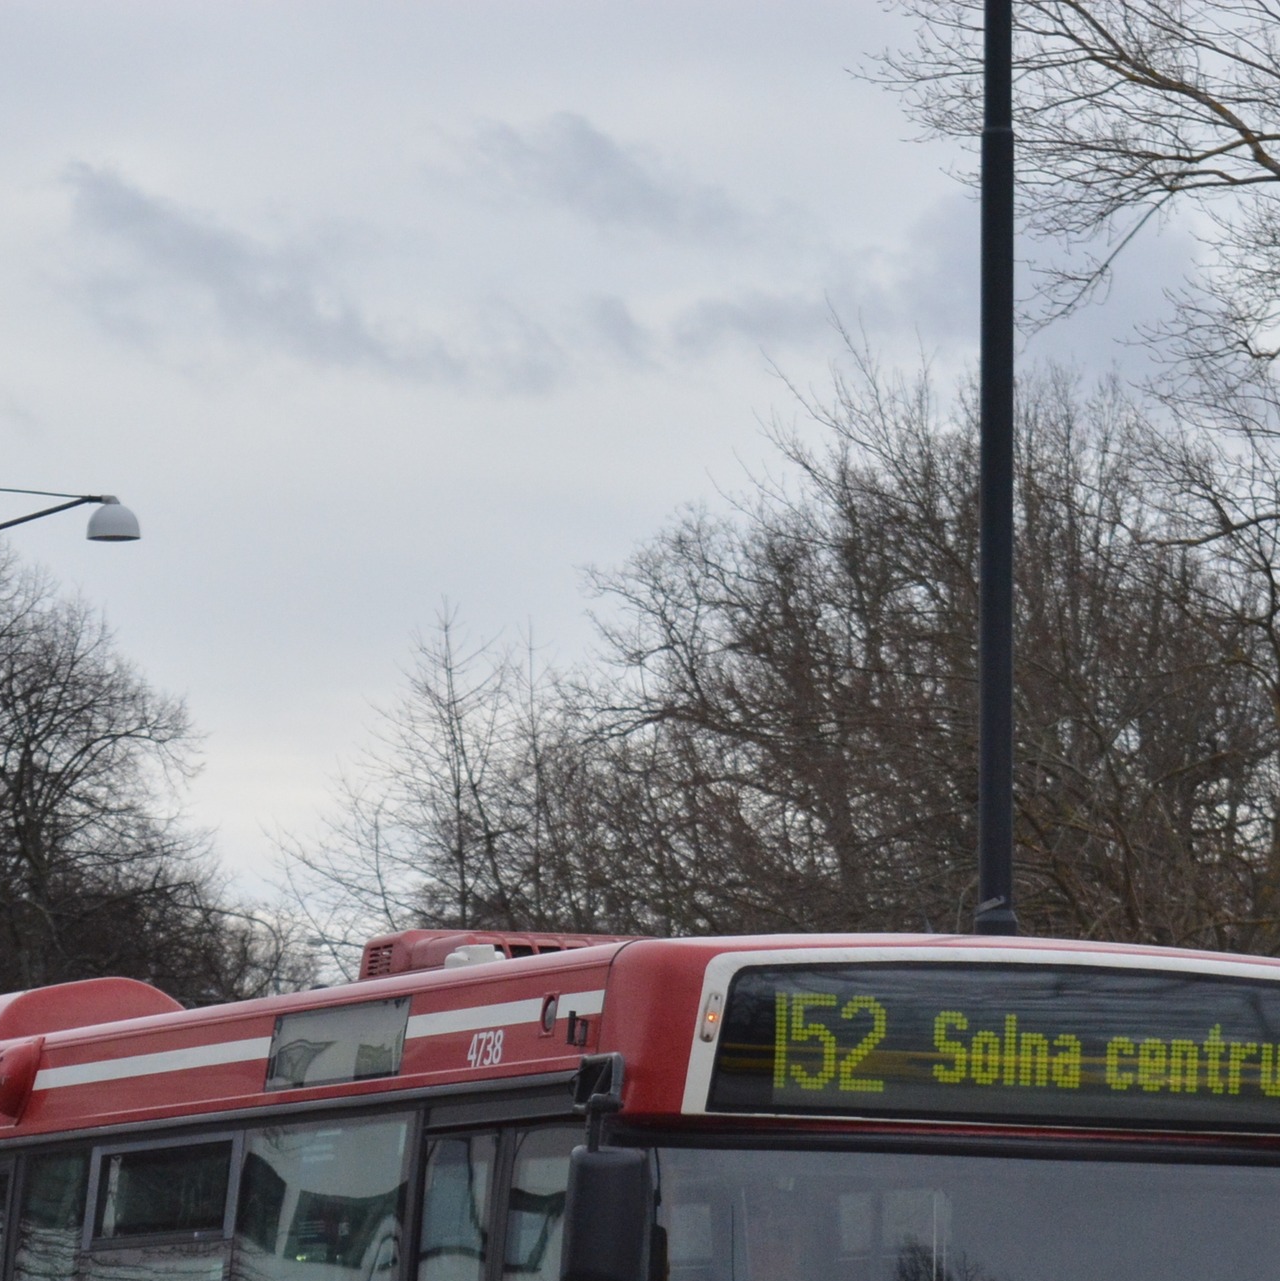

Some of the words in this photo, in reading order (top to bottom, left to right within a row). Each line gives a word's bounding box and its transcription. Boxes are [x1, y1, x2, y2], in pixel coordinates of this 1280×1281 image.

[467, 1029, 504, 1069] 4738
[774, 990, 887, 1092] 152
[932, 1011, 1082, 1091] Solna
